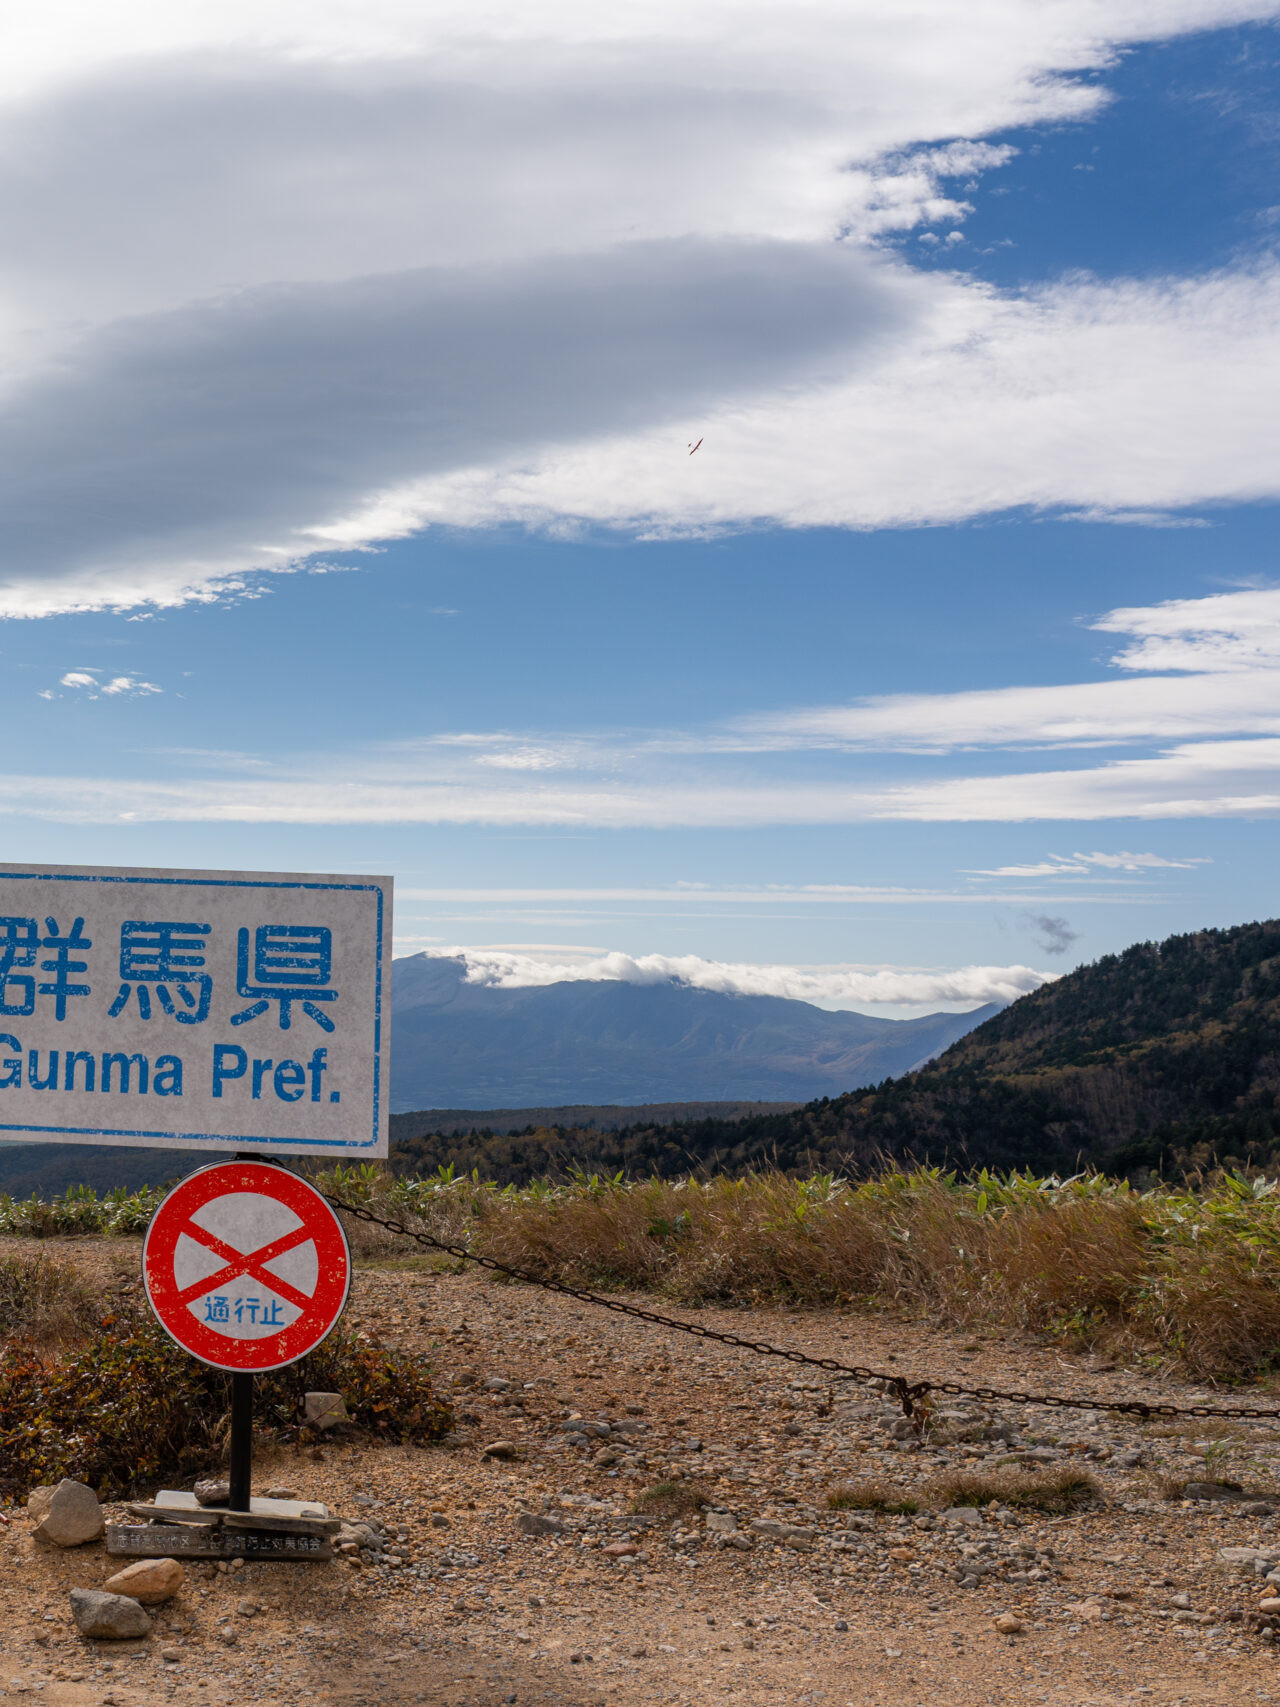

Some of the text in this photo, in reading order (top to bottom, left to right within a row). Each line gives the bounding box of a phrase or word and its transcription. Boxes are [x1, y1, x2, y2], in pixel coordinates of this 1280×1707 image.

[212, 1043, 341, 1105] Pref.
[204, 1296, 285, 1326] 通行止
